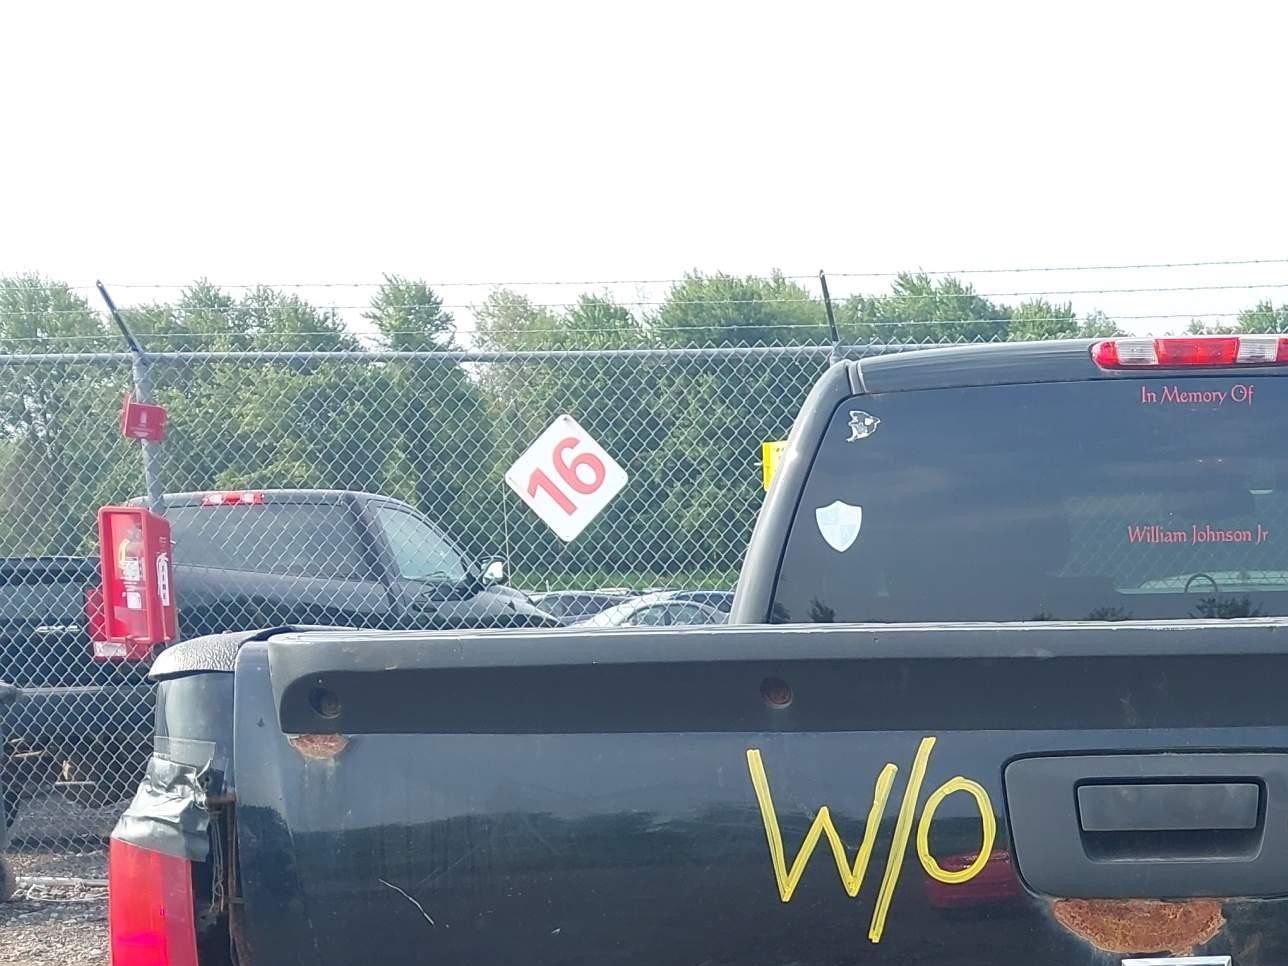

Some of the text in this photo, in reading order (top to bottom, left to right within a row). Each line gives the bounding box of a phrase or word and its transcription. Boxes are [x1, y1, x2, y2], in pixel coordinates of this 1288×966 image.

[1141, 384, 1255, 407] In Memory Of
[527, 436, 607, 517] 16
[1127, 523, 1269, 546] William Johnson Jr
